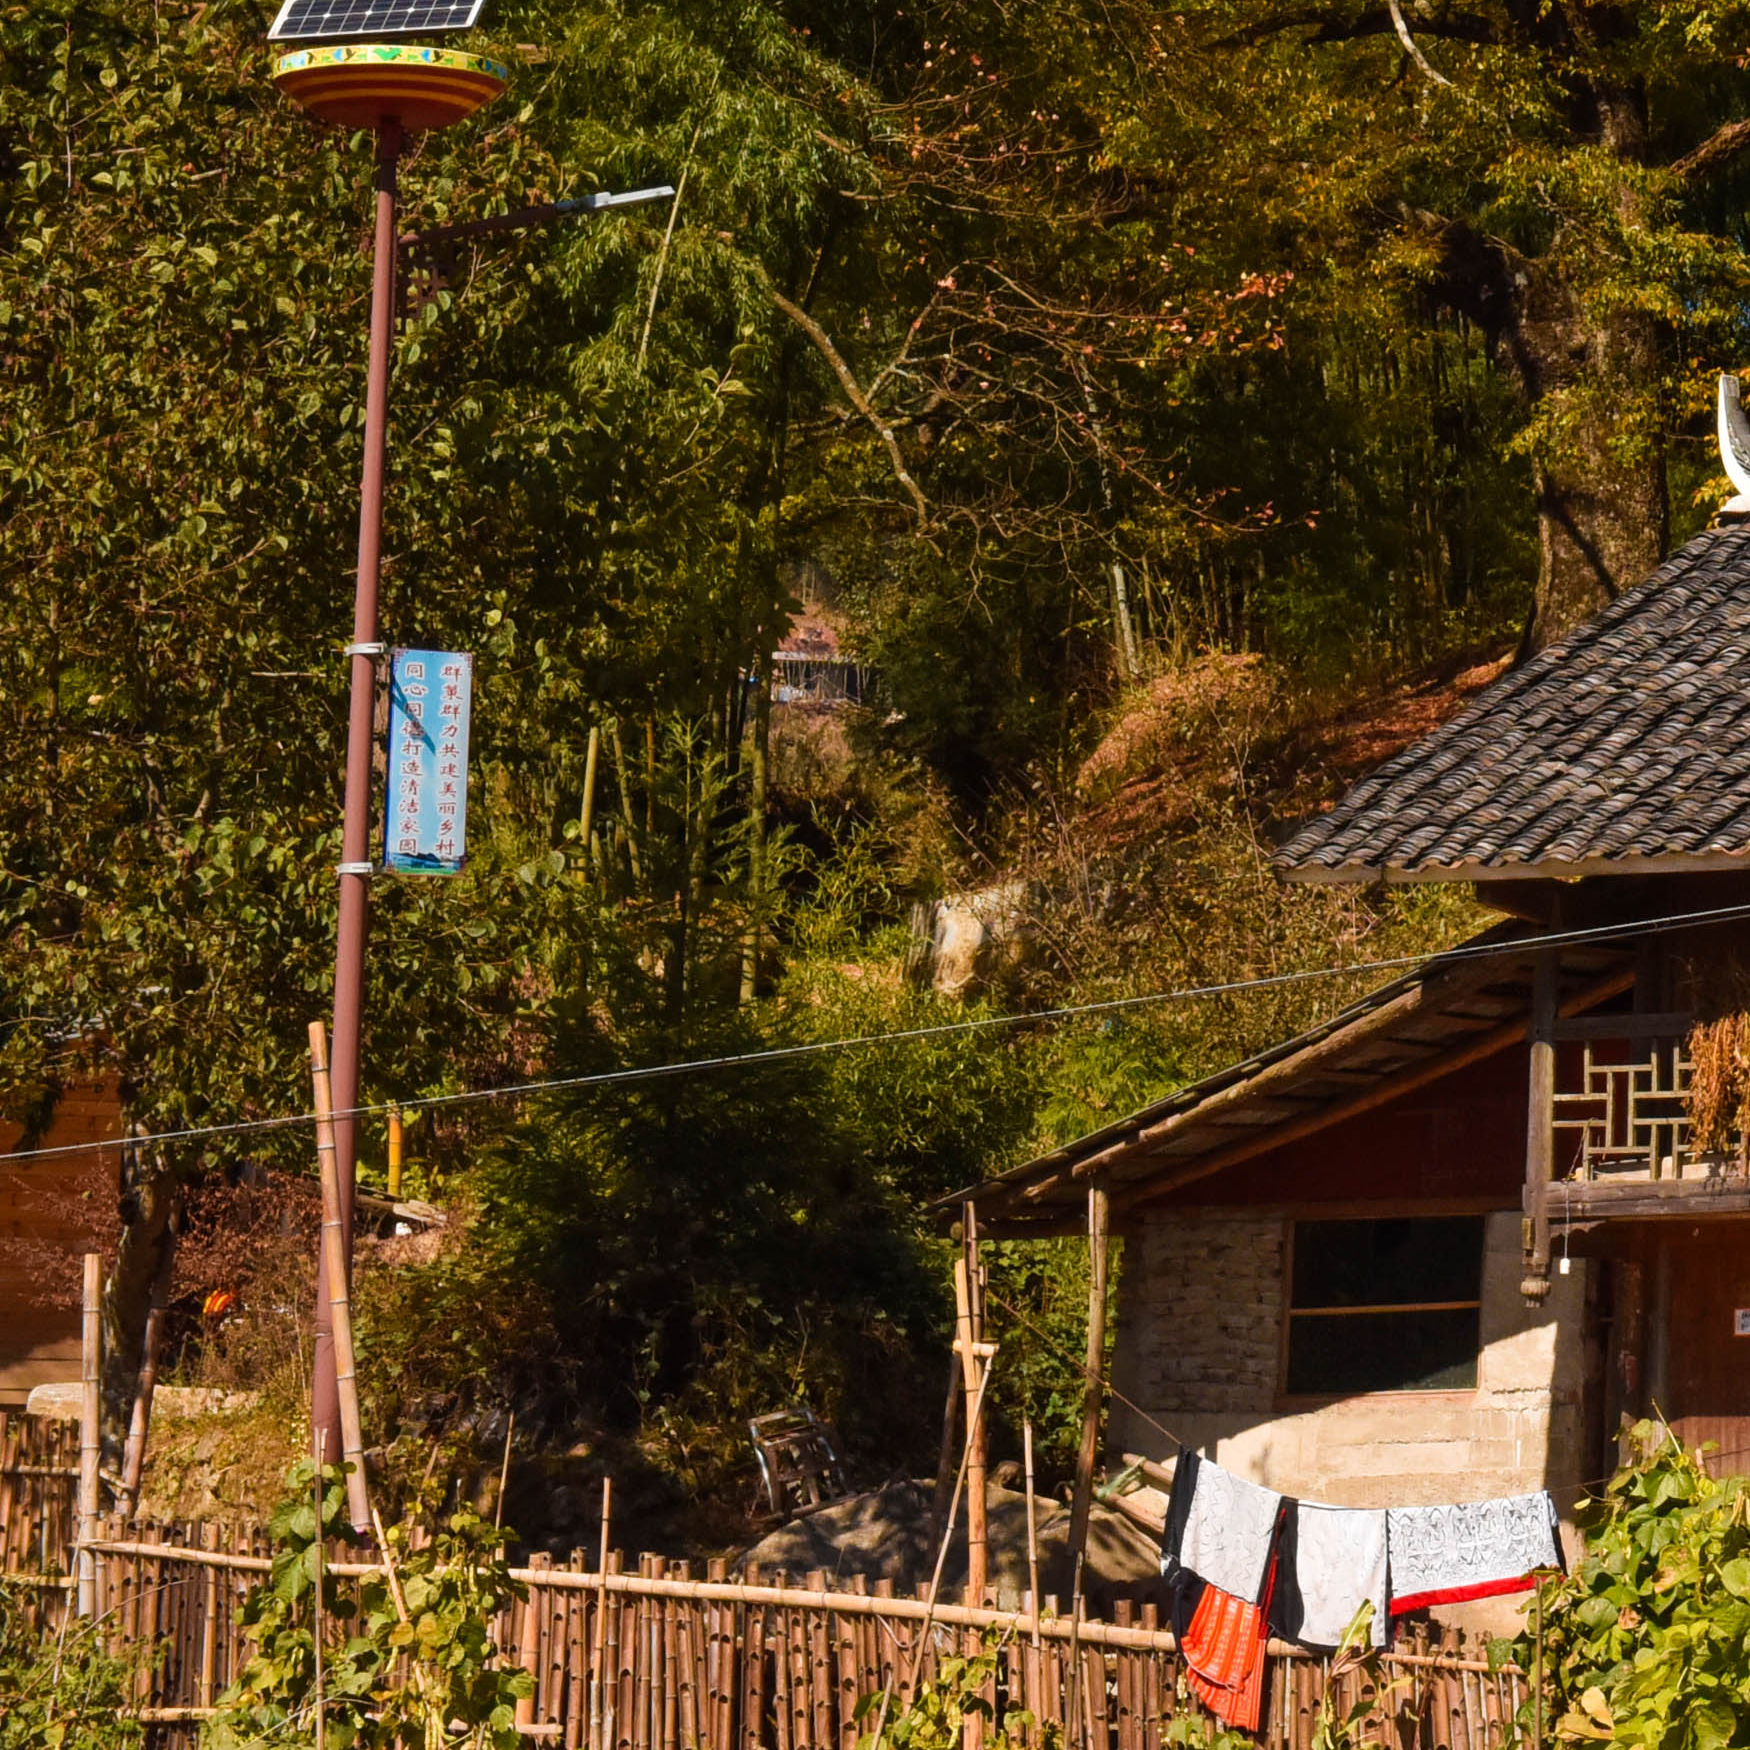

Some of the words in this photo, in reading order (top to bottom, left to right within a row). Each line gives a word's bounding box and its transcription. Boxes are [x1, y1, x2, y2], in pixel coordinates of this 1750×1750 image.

[399, 663, 428, 854] 同心同德打造清洁家园
[435, 665, 464, 856] 群策群力共建美丽乡村
